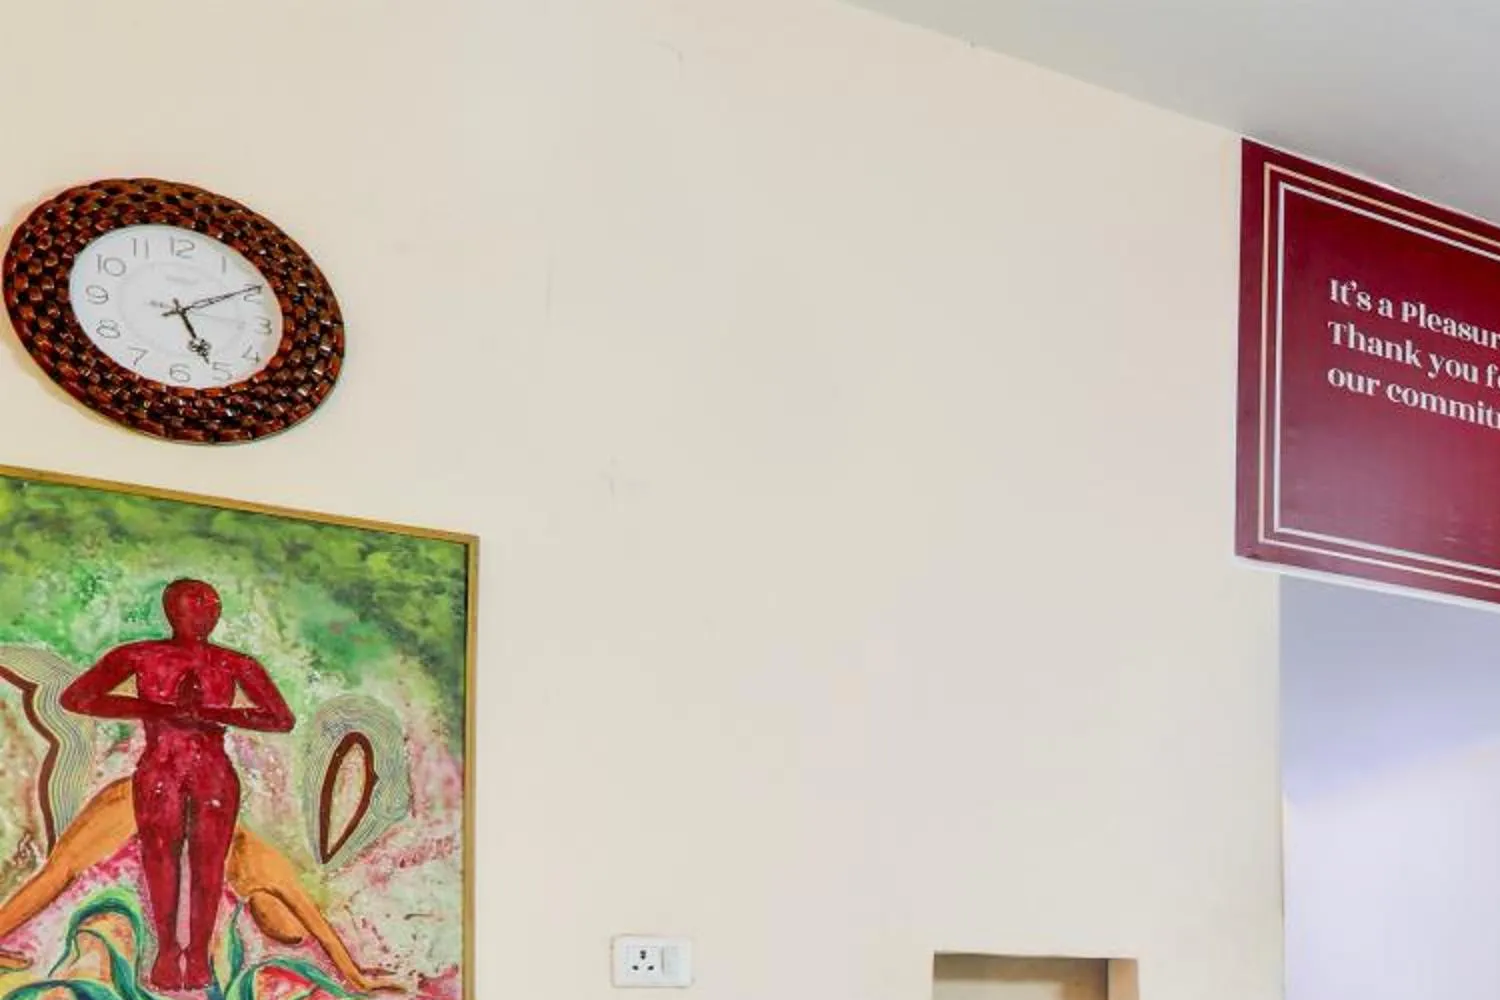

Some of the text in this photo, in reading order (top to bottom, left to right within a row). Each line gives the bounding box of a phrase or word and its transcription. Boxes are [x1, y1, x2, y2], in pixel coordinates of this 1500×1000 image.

[132, 238, 149, 259] 11
[169, 236, 196, 259] 12
[96, 254, 127, 277] 10
[86, 285, 109, 305] 9
[1329, 279, 1372, 312] It's
[1378, 297, 1393, 318] a
[96, 319, 121, 339] 8
[255, 315, 272, 335] 3
[128, 346, 149, 366] 7
[241, 345, 261, 364] 4
[1328, 320, 1422, 368] Thank
[1428, 352, 1478, 384] you
[170, 363, 191, 383] 6
[212, 362, 233, 382] 5
[1328, 367, 1380, 397] our
